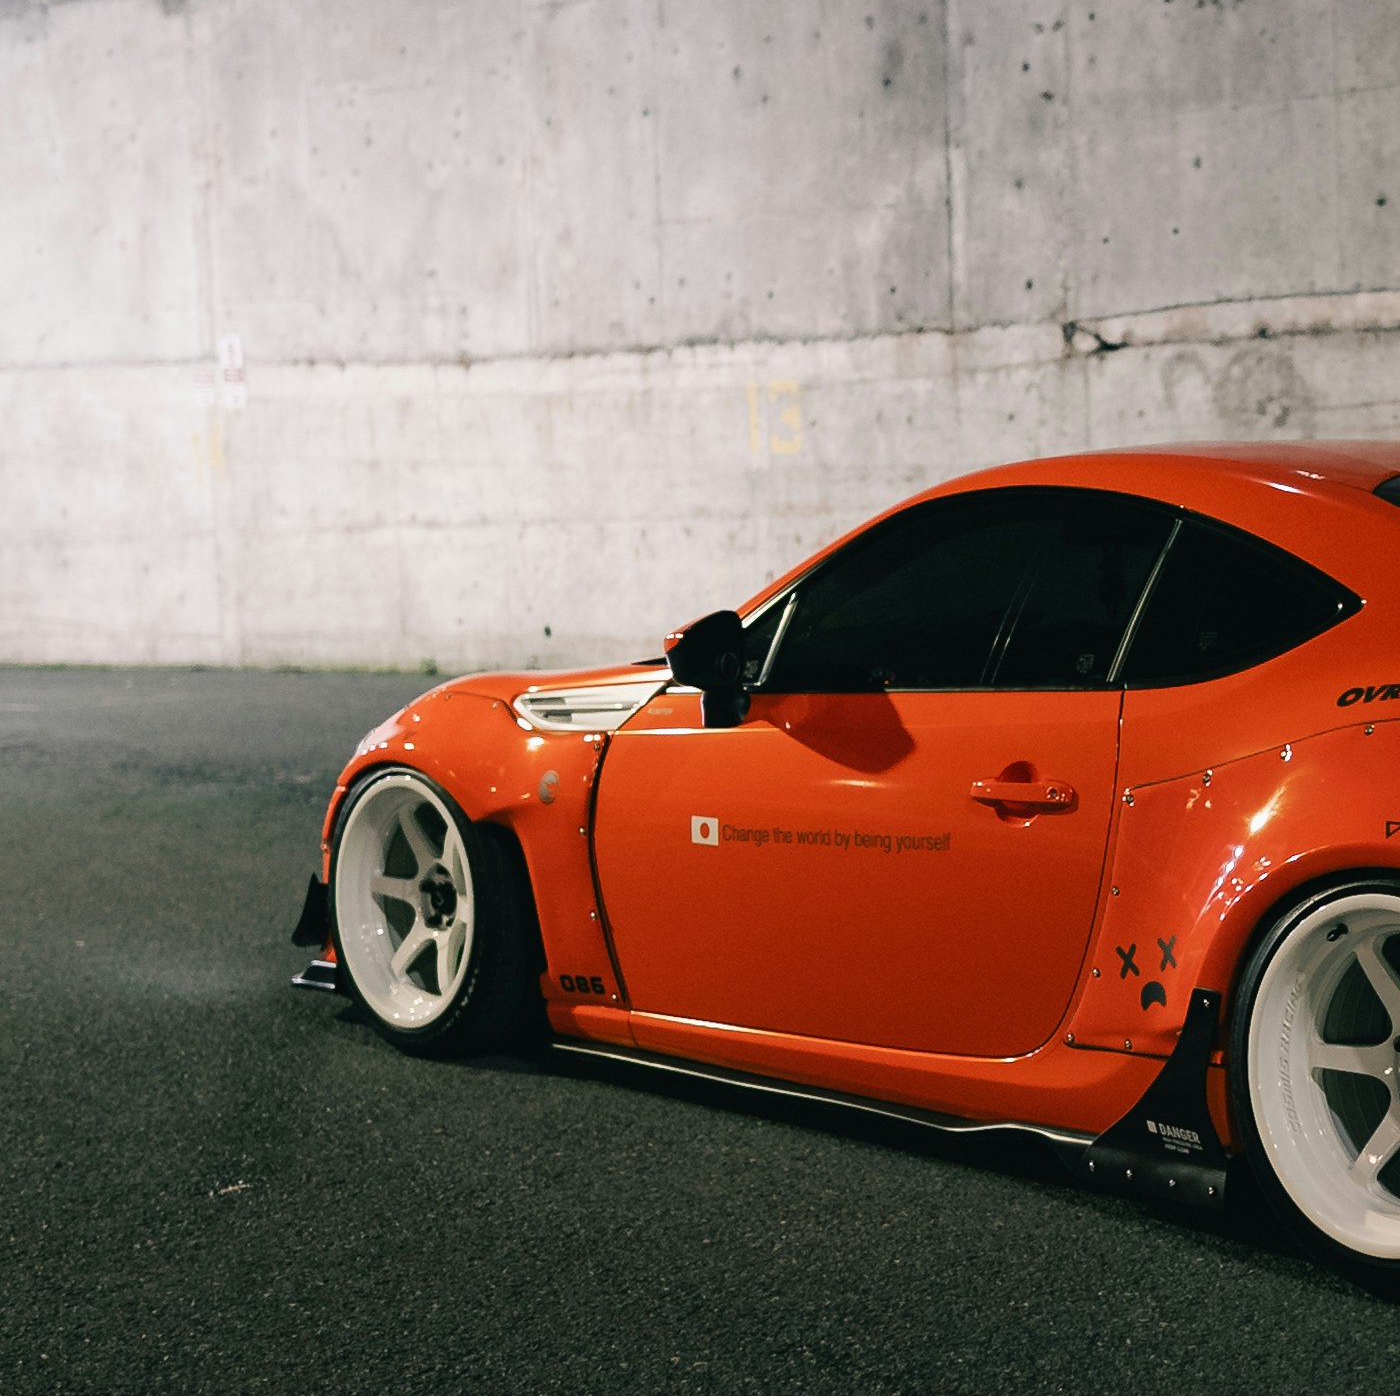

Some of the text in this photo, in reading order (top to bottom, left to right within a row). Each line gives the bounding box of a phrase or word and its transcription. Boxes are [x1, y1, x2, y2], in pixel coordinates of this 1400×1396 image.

[745, 378, 802, 455] 13
[722, 823, 952, 854] Change the world by being yourself
[559, 974, 606, 995] 086
[1278, 977, 1303, 1134] COSMIS RACING
[1158, 1122, 1201, 1144] DANGER
